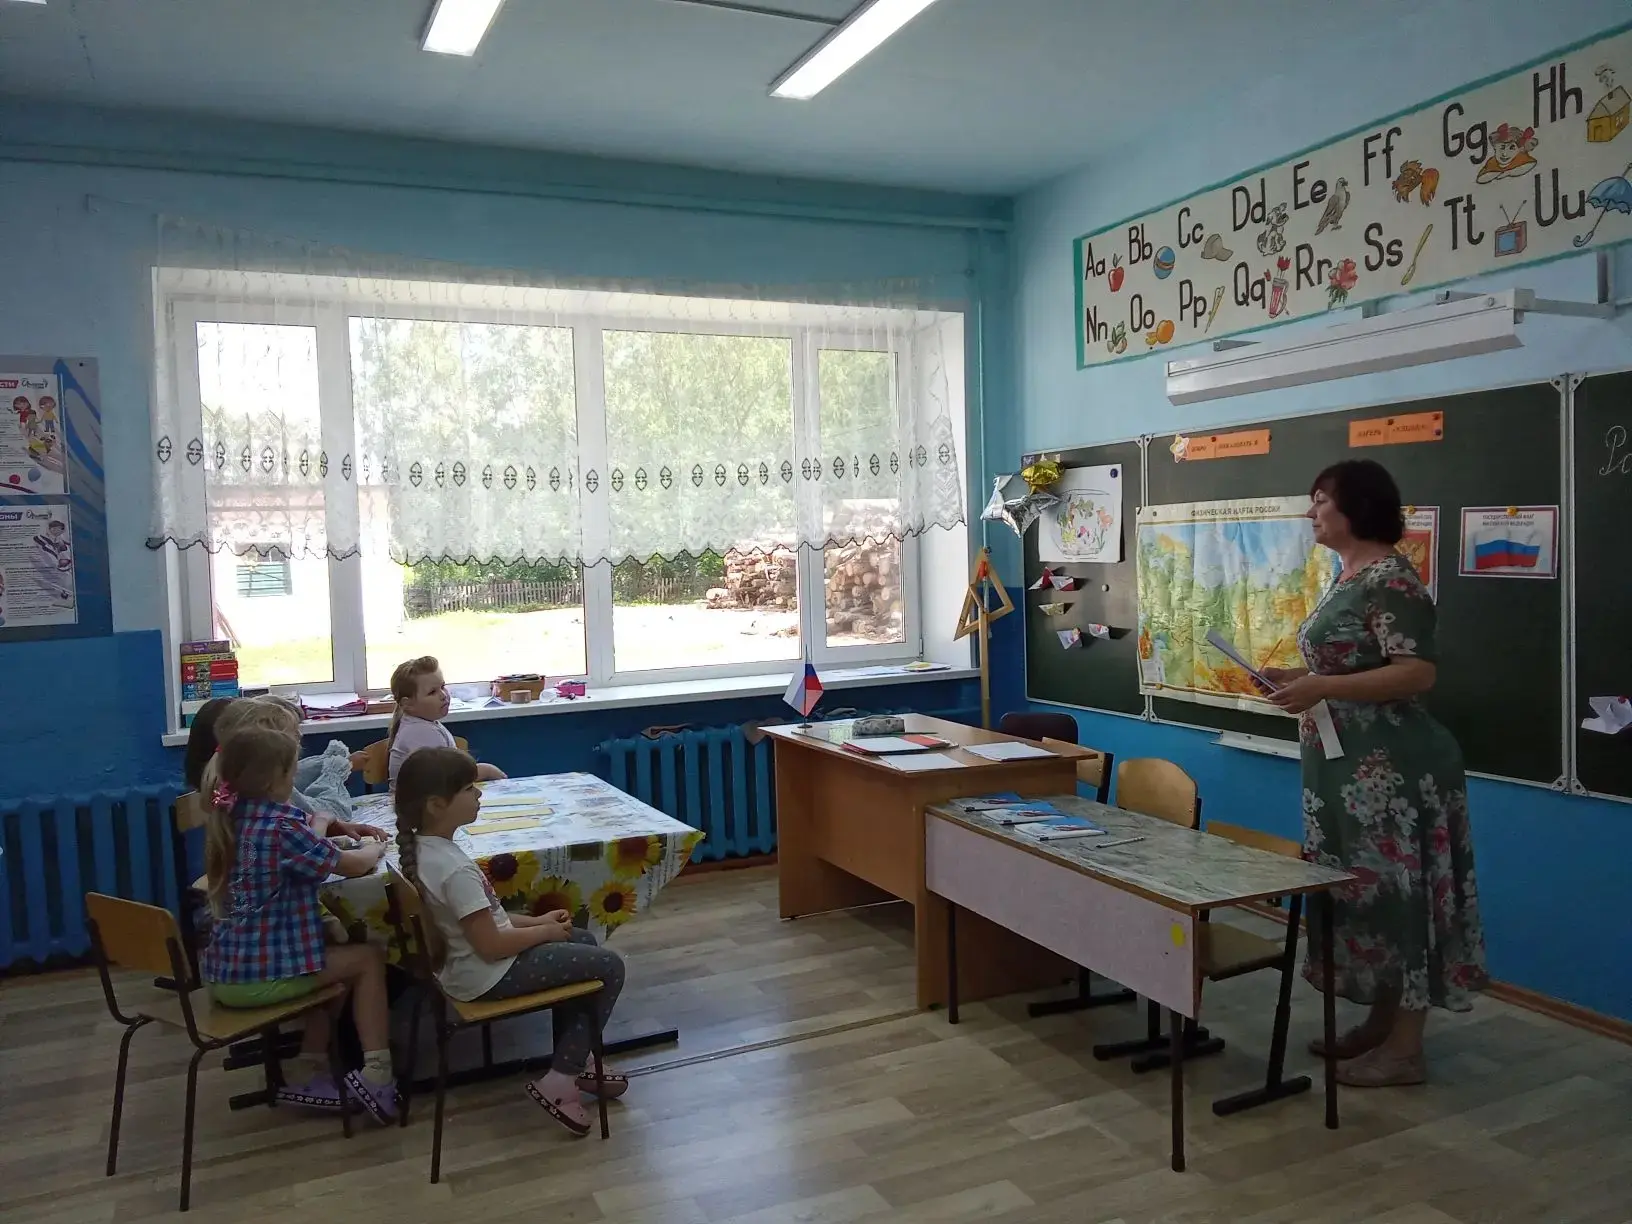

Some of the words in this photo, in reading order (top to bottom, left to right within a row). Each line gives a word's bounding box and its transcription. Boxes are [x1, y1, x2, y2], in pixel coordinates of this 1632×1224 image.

[1085, 242, 1106, 280] Aa
[1128, 224, 1153, 265] Bb
[1177, 206, 1204, 249] Cc
[1232, 177, 1266, 231] Dd
[1293, 160, 1327, 210] Ee
[1363, 126, 1402, 186] Ff
[1443, 102, 1488, 165] Gg
[1533, 62, 1583, 129] Hh
[1086, 305, 1108, 344] Nn
[1130, 293, 1155, 334] Oo
[1179, 279, 1207, 328] Pp
[1234, 261, 1266, 310] Qq
[1295, 242, 1332, 291] Rr
[1364, 222, 1404, 272] Ss
[1443, 194, 1485, 250] Tt
[1535, 168, 1586, 227] Uu
